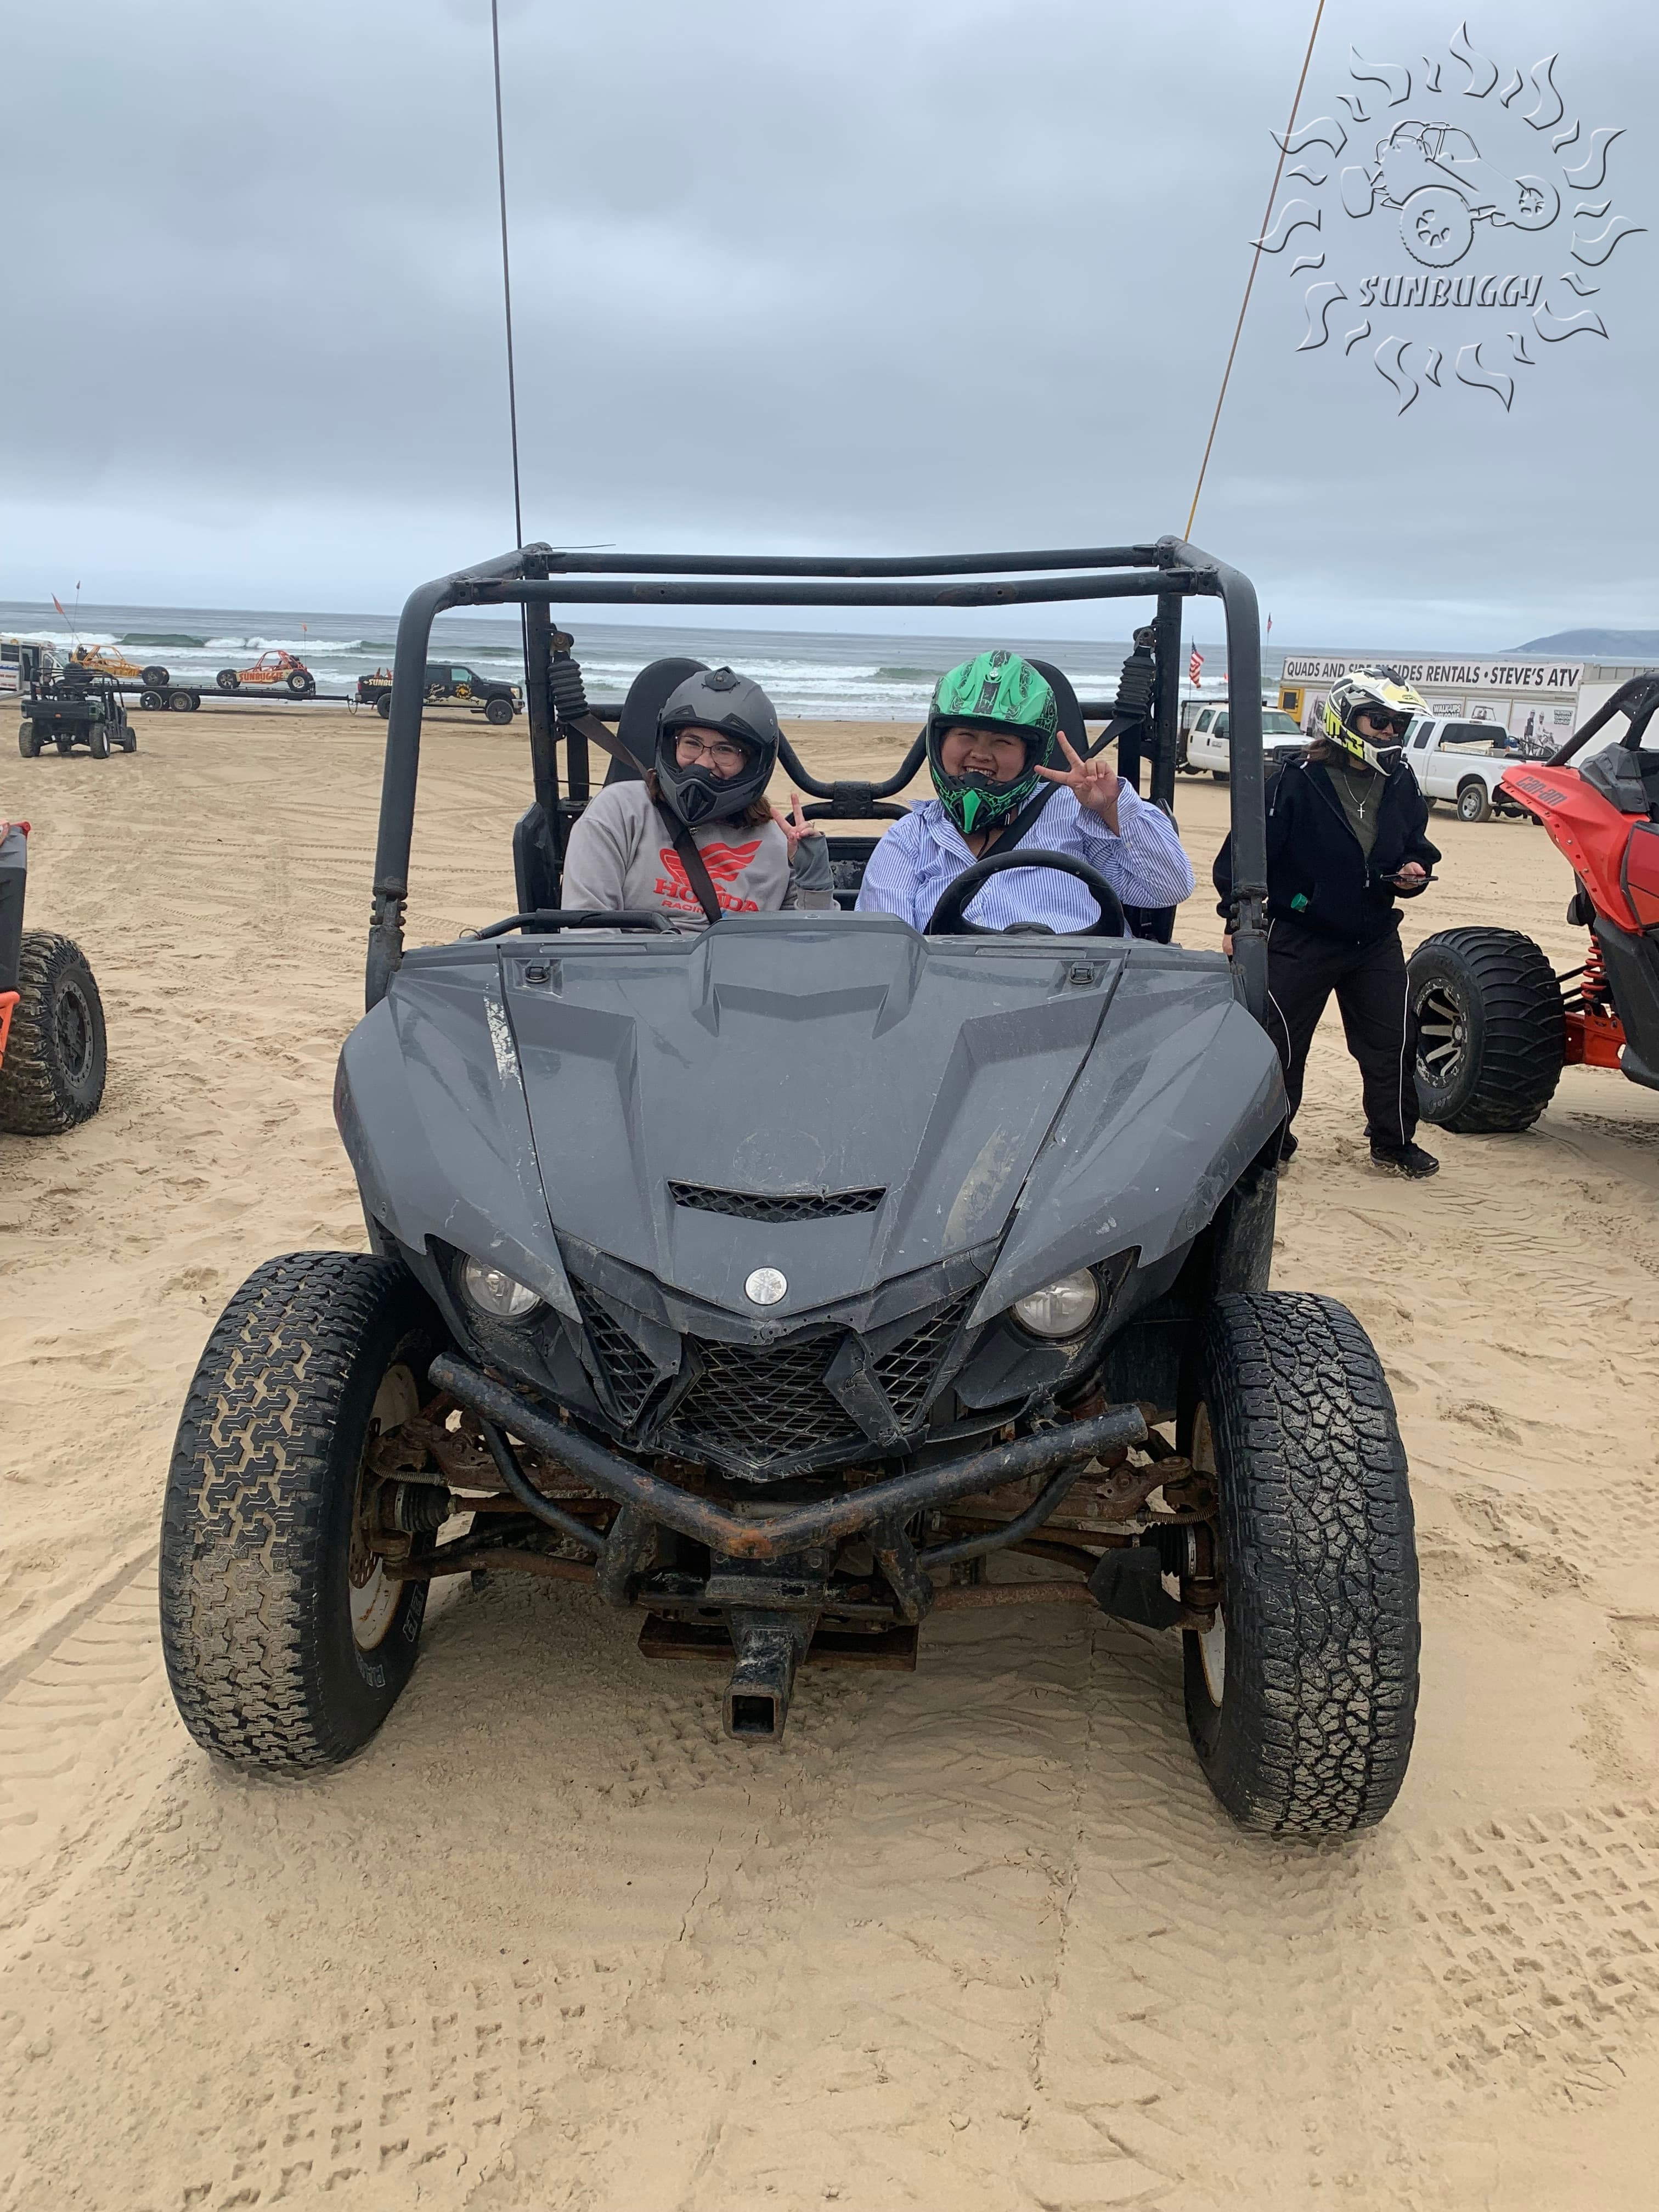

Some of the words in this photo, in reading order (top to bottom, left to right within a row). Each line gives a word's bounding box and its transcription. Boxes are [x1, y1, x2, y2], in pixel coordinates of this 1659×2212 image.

[1287, 661, 1319, 677] QUADS
[1322, 663, 1345, 678] AND
[1426, 665, 1480, 683] RENTALS
[1490, 667, 1544, 686] STEVE'S
[1547, 669, 1579, 686] ATV
